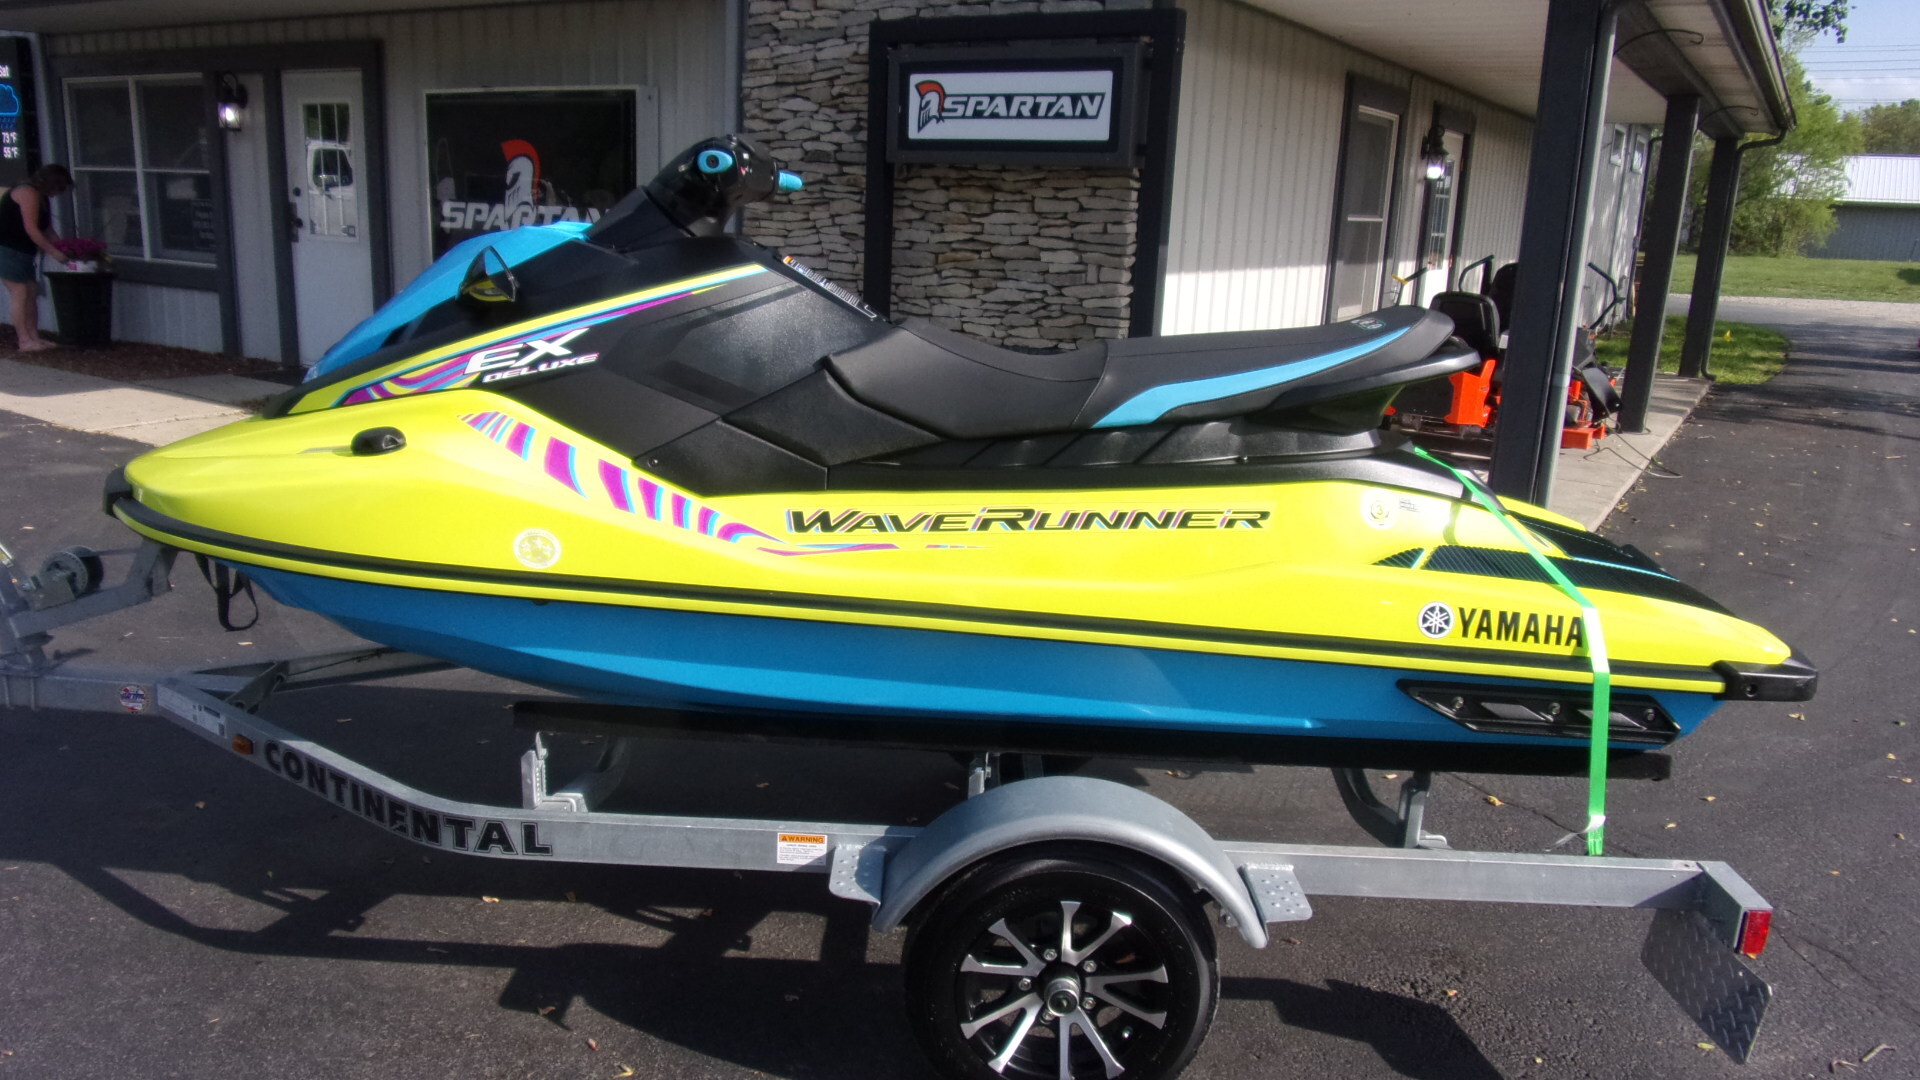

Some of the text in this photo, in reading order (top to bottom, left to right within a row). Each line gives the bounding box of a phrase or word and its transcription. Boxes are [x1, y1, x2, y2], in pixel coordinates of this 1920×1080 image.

[942, 94, 1103, 118] SPARTAN
[463, 327, 590, 375] EX
[482, 352, 600, 383] DELUXE
[1458, 606, 1584, 648] YAMAHA
[264, 738, 553, 857] CONTINENTAL
[788, 835, 824, 844] WARNING
